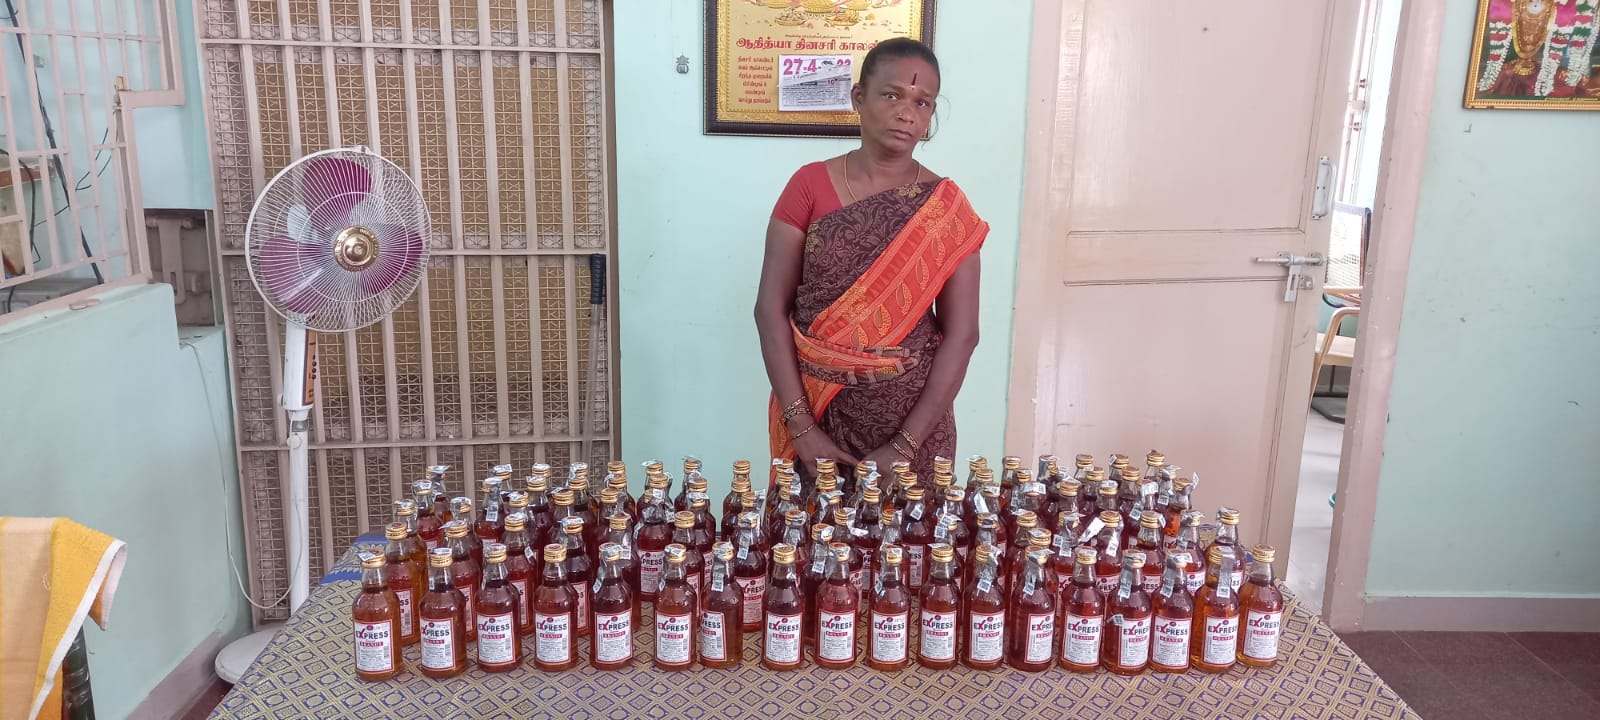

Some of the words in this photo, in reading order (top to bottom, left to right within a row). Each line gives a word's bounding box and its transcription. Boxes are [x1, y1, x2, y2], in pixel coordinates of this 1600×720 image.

[478, 621, 510, 633] EXPRESS
[536, 620, 568, 632] EXPRESS
[657, 620, 689, 632] EXPRESS
[768, 620, 799, 632] EXPRESS
[874, 619, 905, 632] EXPRESS
[922, 617, 953, 630] EXPRESS
[1067, 621, 1099, 634] EXPRESS
[355, 628, 389, 640] EXPRESS
